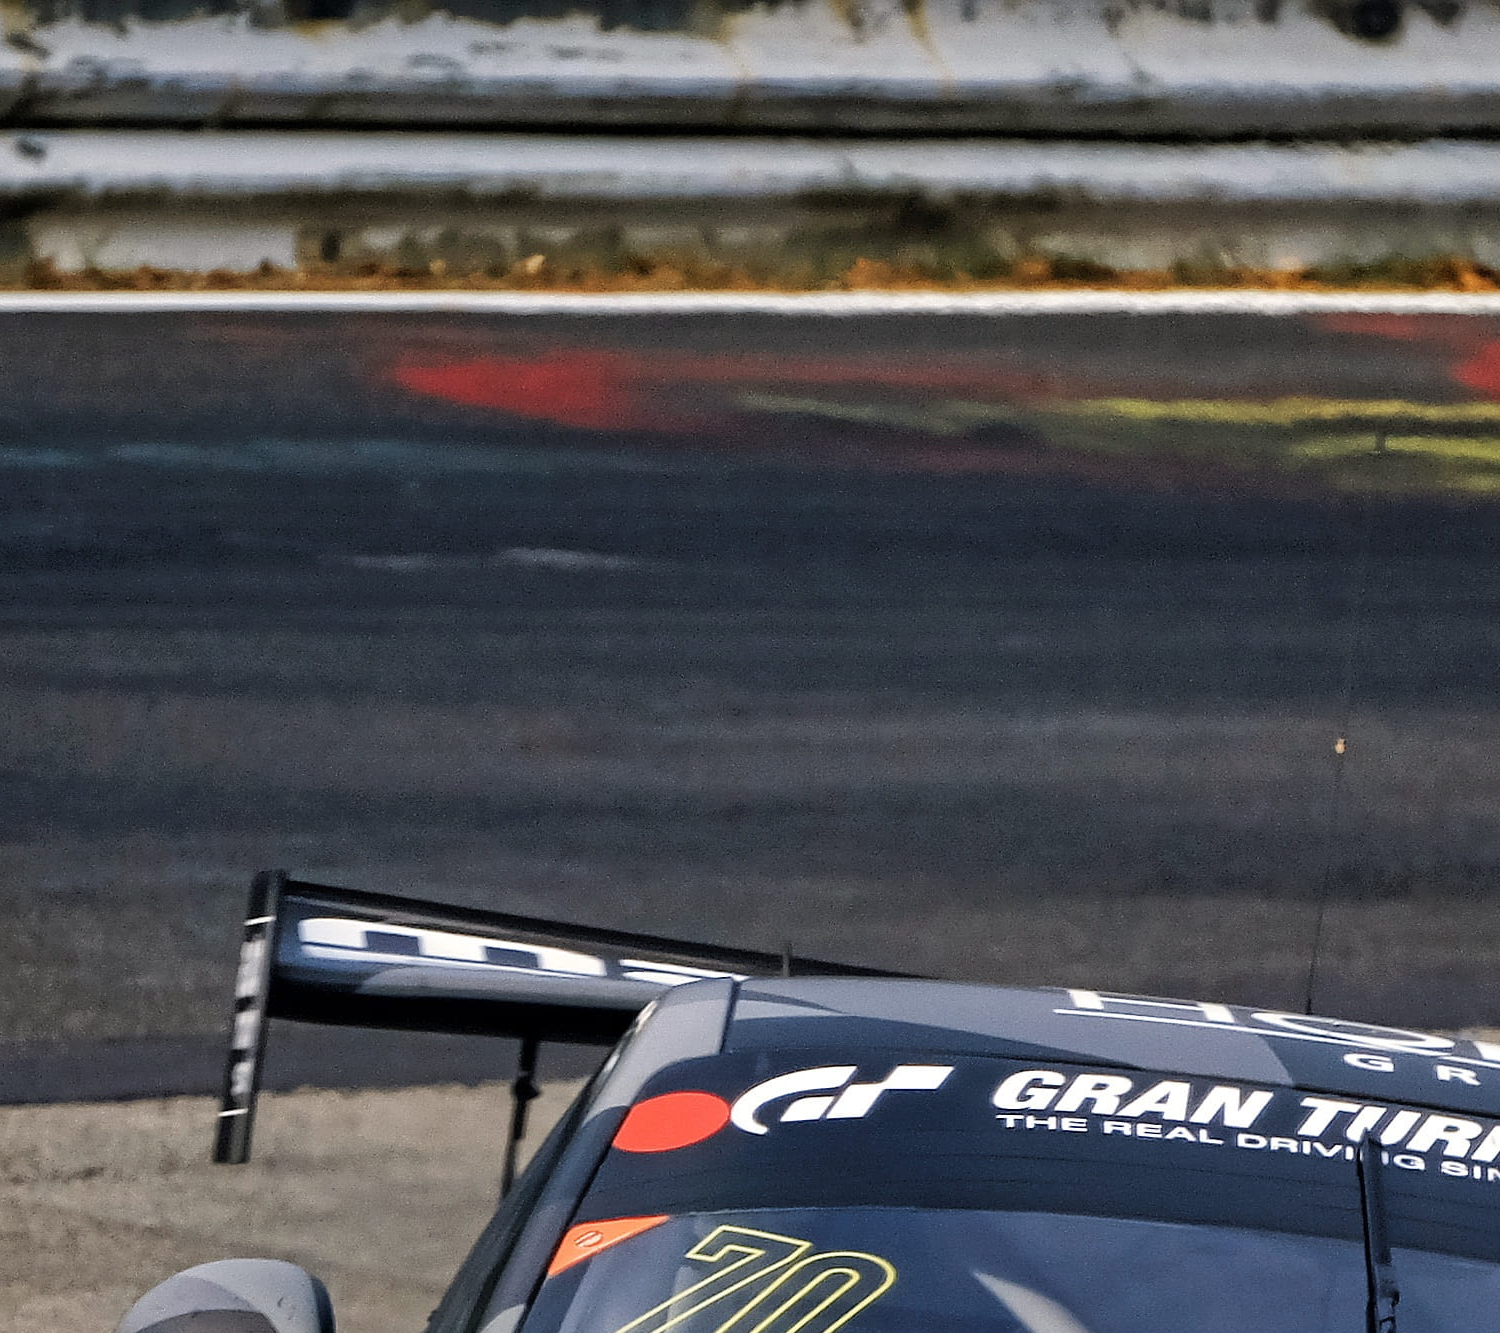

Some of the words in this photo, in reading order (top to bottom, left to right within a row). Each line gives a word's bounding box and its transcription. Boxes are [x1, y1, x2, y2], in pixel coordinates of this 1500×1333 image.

[993, 1069, 1274, 1130] GRAN
[996, 1114, 1088, 1133] THE
[1103, 1120, 1225, 1146] REAL
